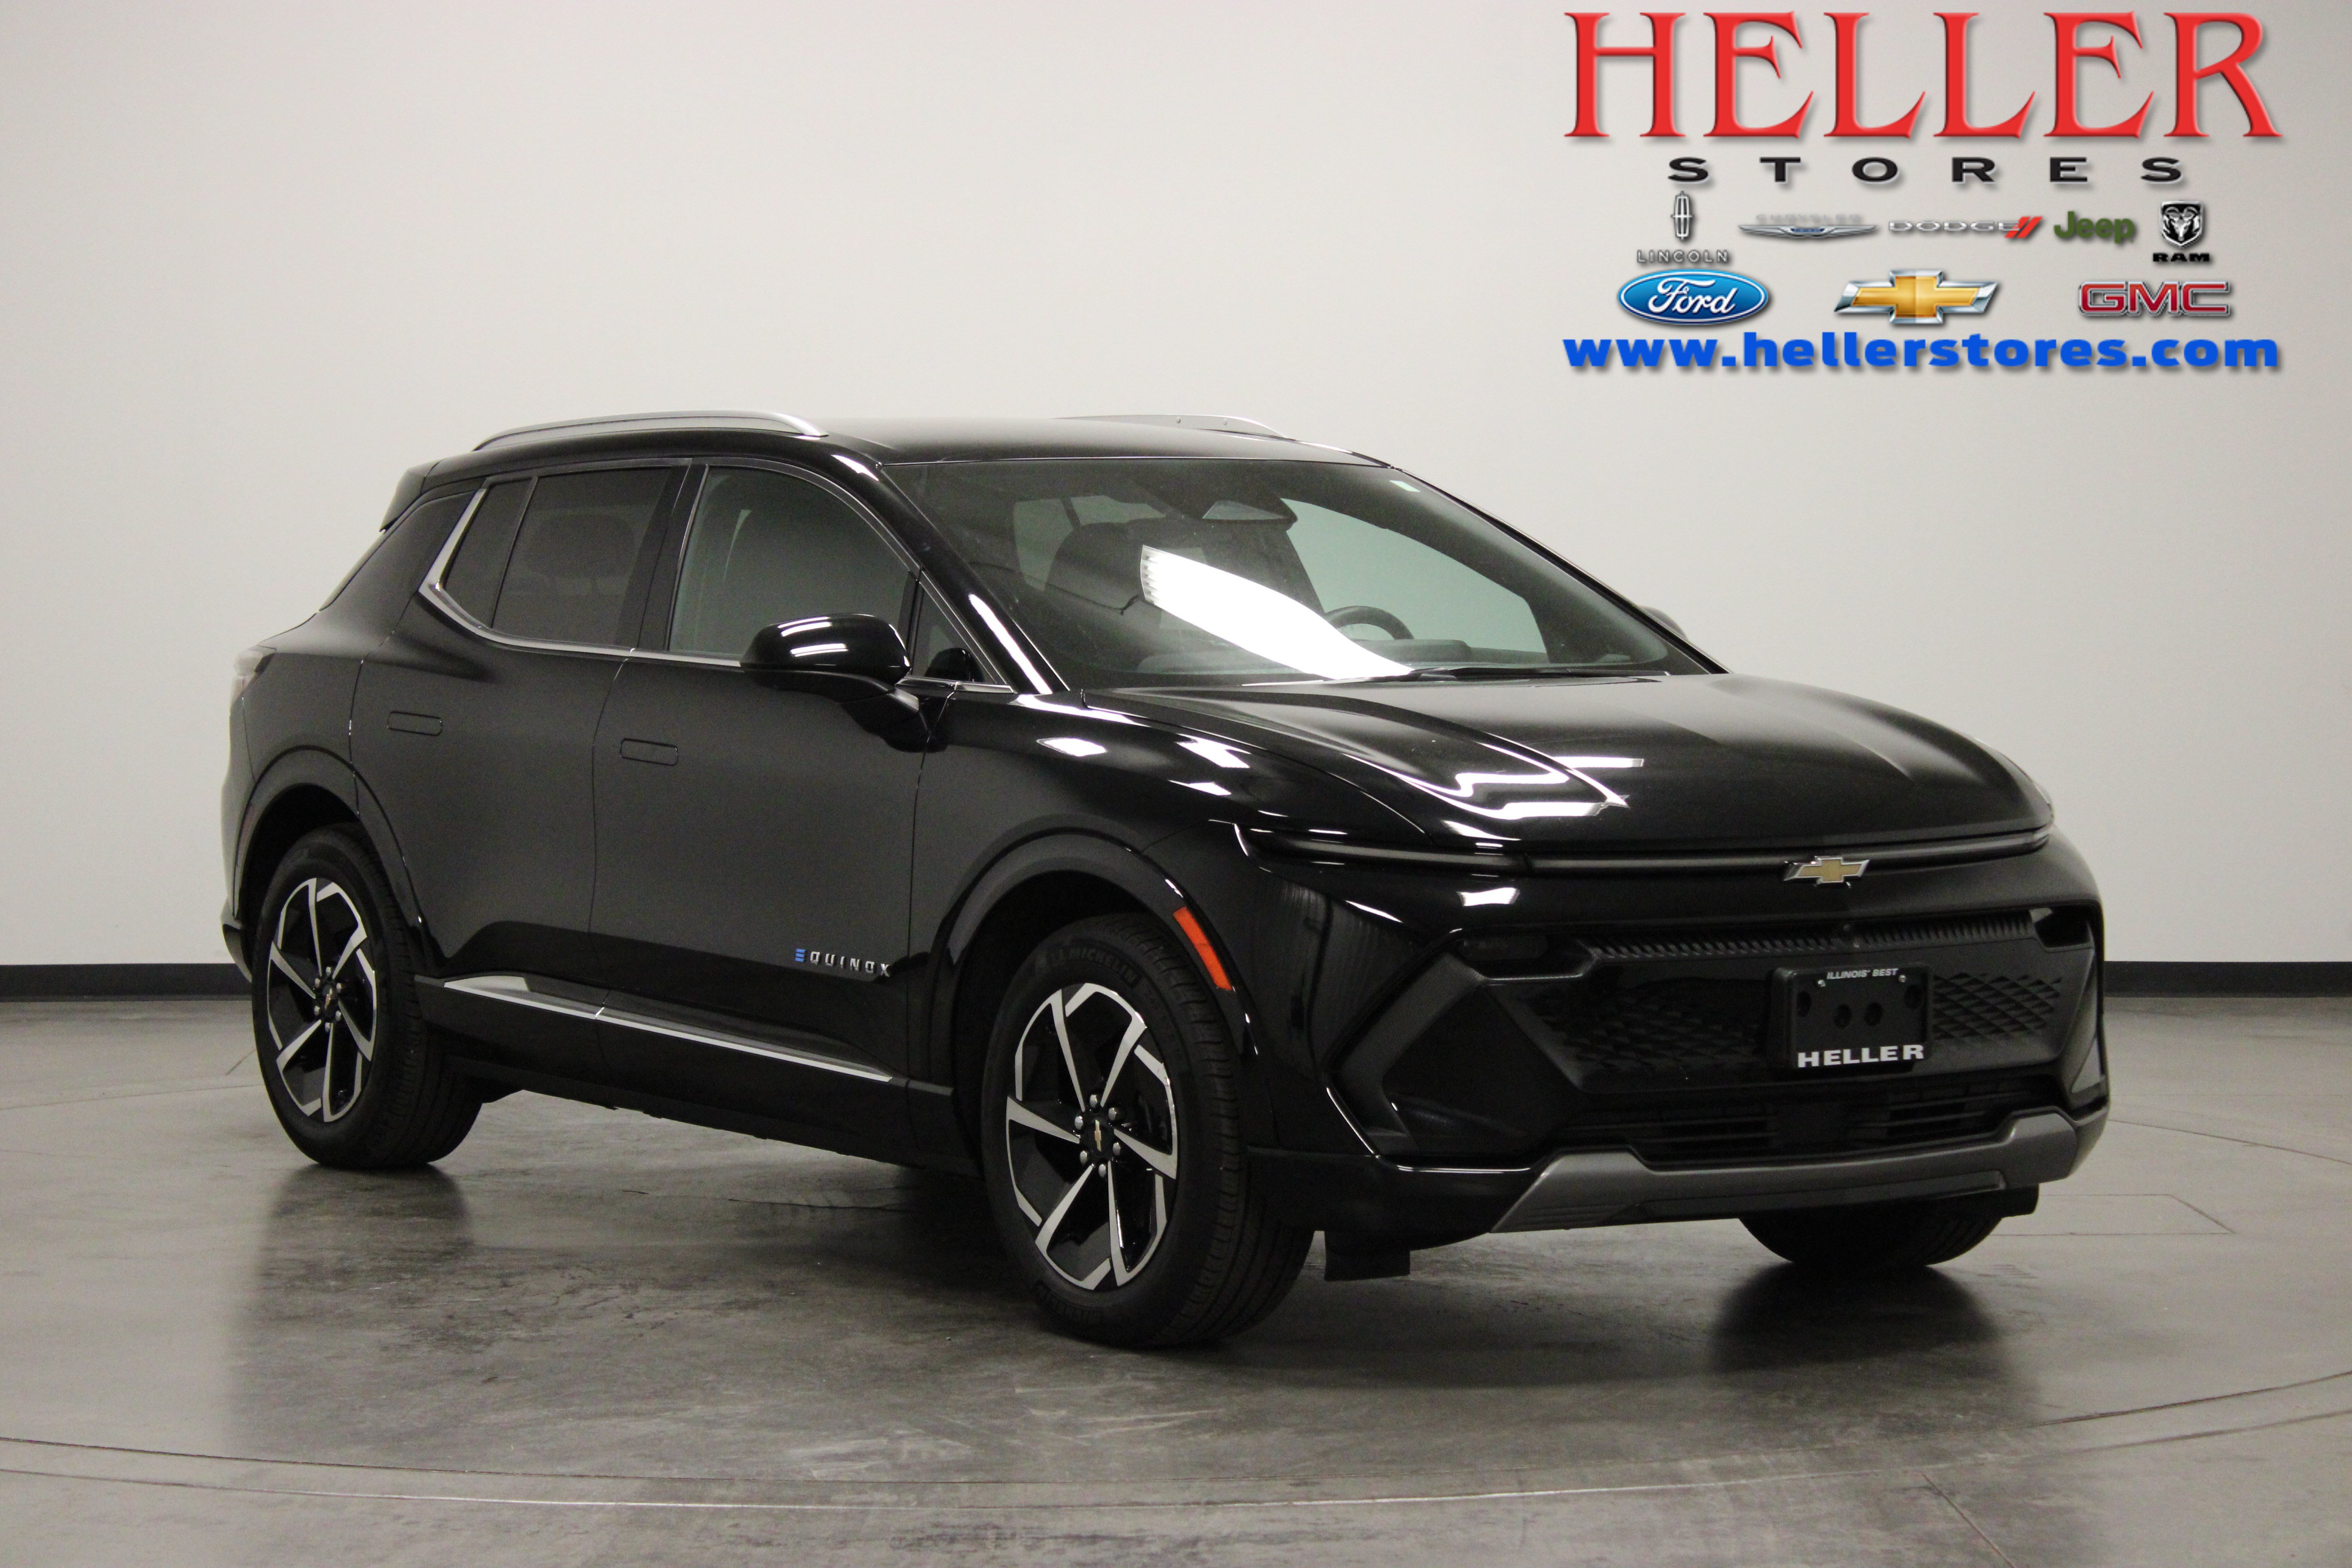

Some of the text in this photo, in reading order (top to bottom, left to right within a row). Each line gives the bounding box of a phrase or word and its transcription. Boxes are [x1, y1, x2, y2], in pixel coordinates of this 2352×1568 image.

[795, 948, 890, 977] EQUINOX
[1872, 968, 1899, 977] BEST
[1798, 1045, 1924, 1068] HELLER
